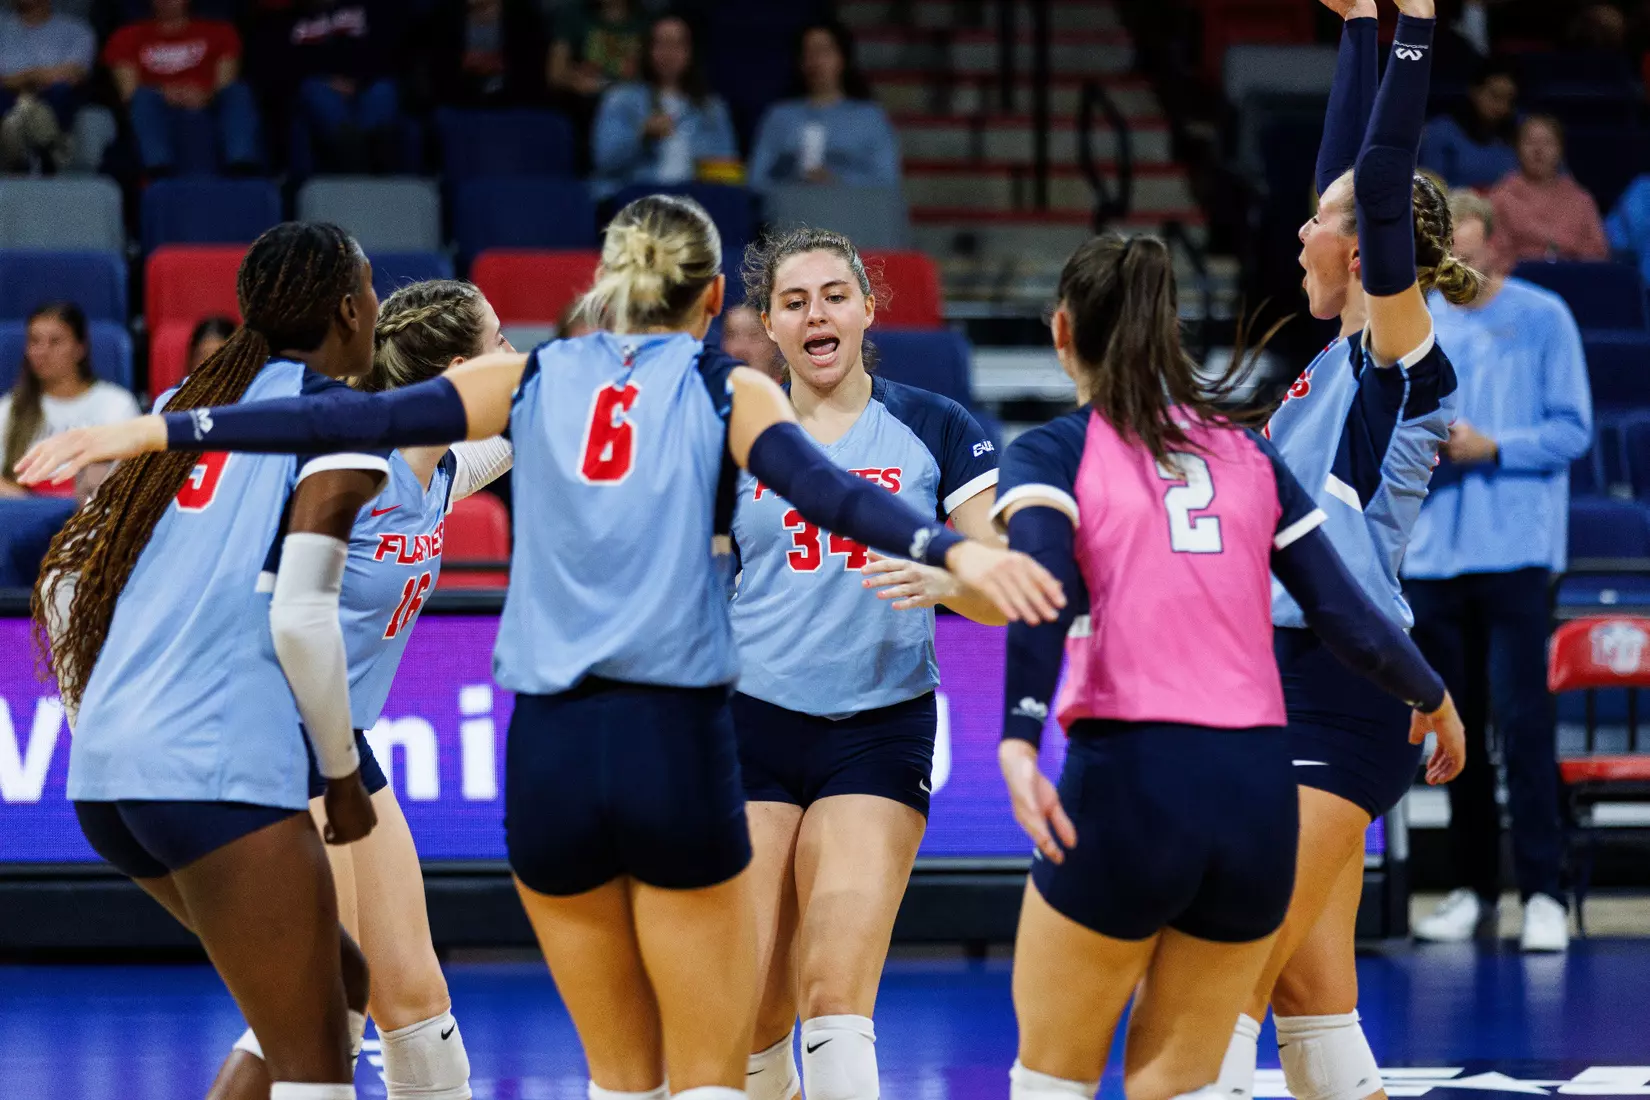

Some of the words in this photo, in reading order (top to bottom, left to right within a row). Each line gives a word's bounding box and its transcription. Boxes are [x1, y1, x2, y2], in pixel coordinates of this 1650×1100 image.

[576, 380, 643, 486] 6
[781, 506, 869, 573] 34
[1153, 451, 1224, 554] 2
[381, 569, 432, 640] 16
